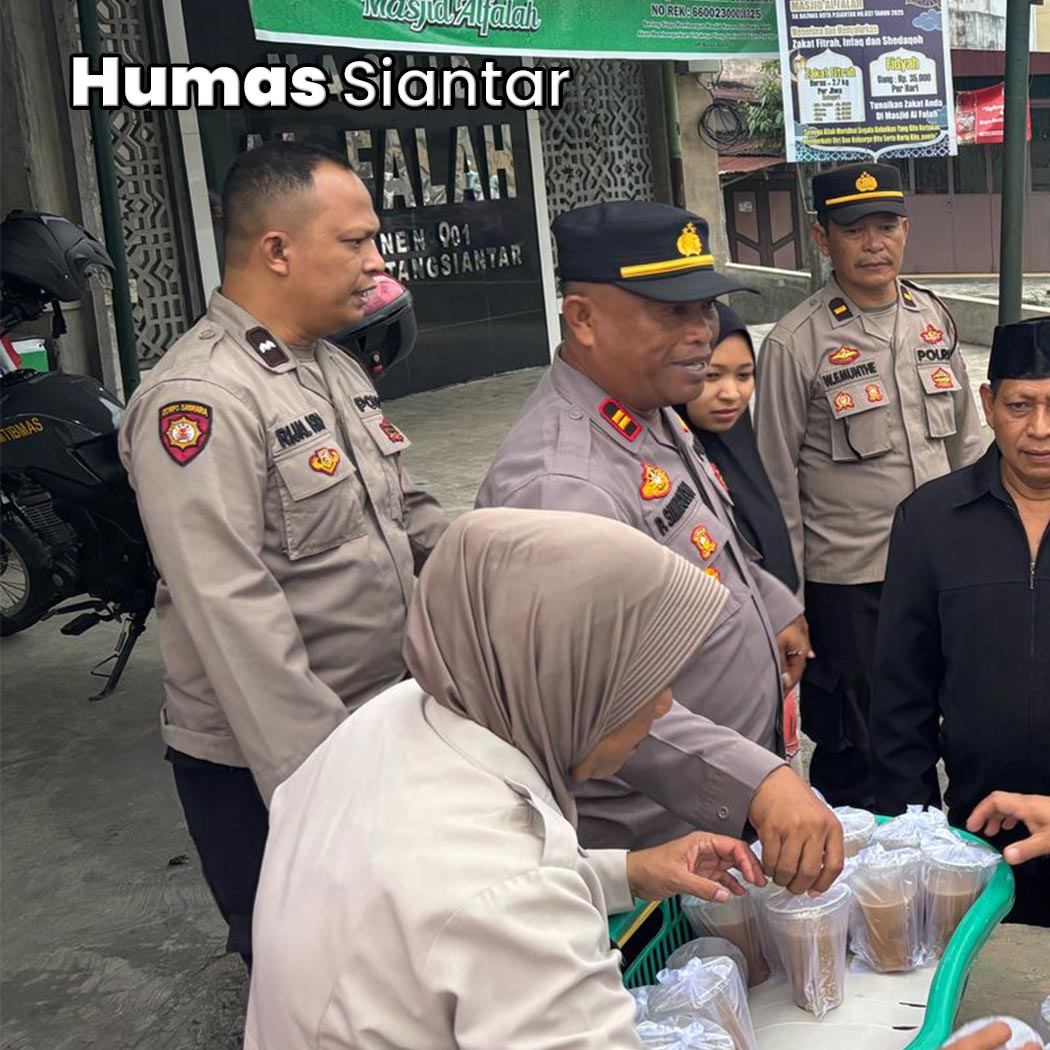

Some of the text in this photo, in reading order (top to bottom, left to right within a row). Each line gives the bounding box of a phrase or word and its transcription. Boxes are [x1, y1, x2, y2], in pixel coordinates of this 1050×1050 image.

[652, 5, 664, 17] NO
[667, 5, 685, 17] REK
[865, 37, 881, 45] dan
[385, 244, 523, 281] TANGSIANTAR
